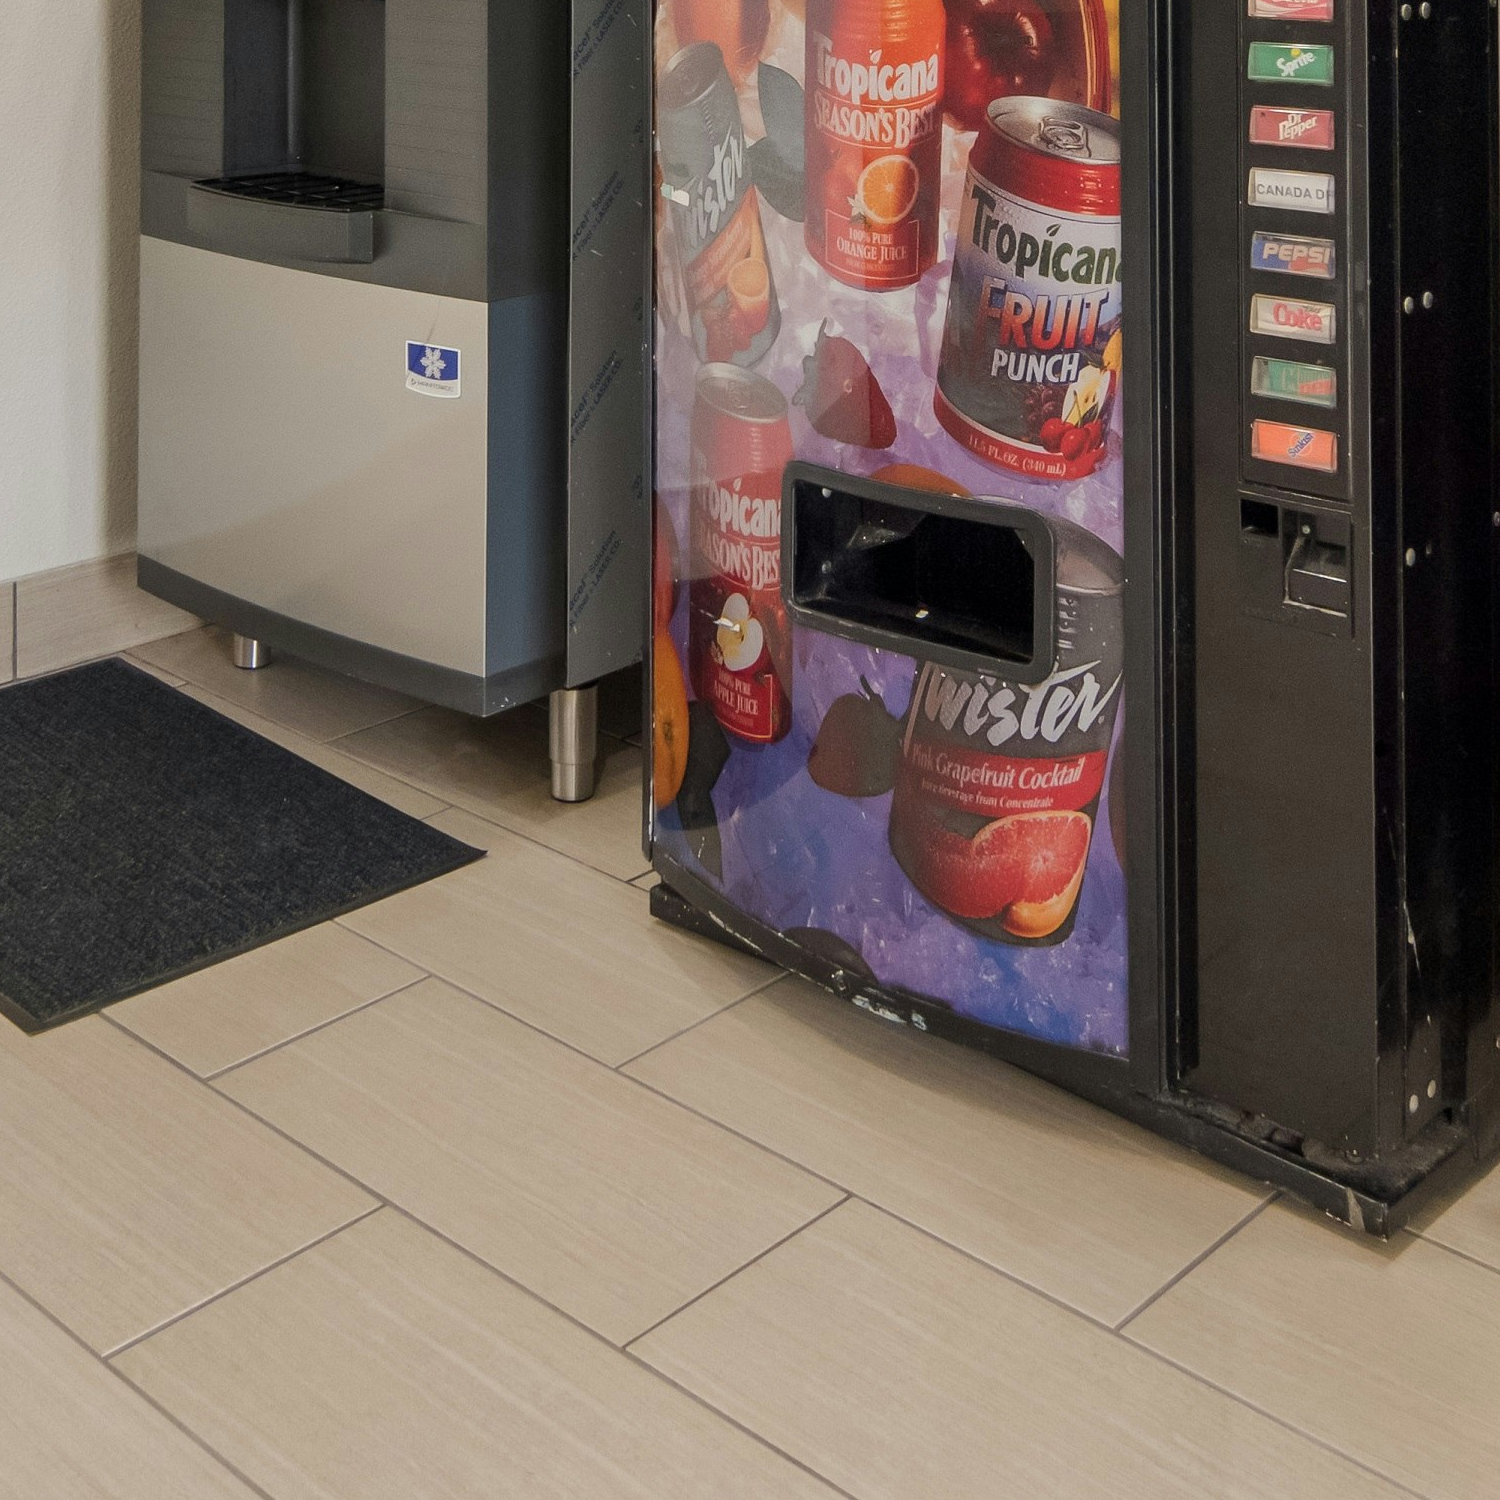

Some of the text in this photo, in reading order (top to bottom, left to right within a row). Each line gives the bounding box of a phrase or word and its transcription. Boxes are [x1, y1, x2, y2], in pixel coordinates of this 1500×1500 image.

[813, 31, 939, 104] Tropicana
[1276, 51, 1317, 77] Sprite
[814, 88, 937, 149] SEASON'S BEST
[1278, 116, 1318, 141] Pepper
[1287, 113, 1302, 125] Dr
[1256, 183, 1312, 199] CANADA
[872, 232, 894, 245] PURE
[971, 185, 1122, 284] Tropican
[836, 236, 908, 264] ORANGE JUICE
[1262, 242, 1331, 264] PEPSI
[973, 275, 1110, 350] FRUIT
[1273, 302, 1322, 331] Coke
[991, 348, 1080, 384] PUNCH
[752, 545, 781, 590] BES
[735, 693, 759, 716] JUICE
[936, 753, 1015, 790] Grapefruit
[1018, 756, 1085, 790] Cocktail
[976, 791, 998, 806] from
[1000, 796, 1055, 809] Concentrate
